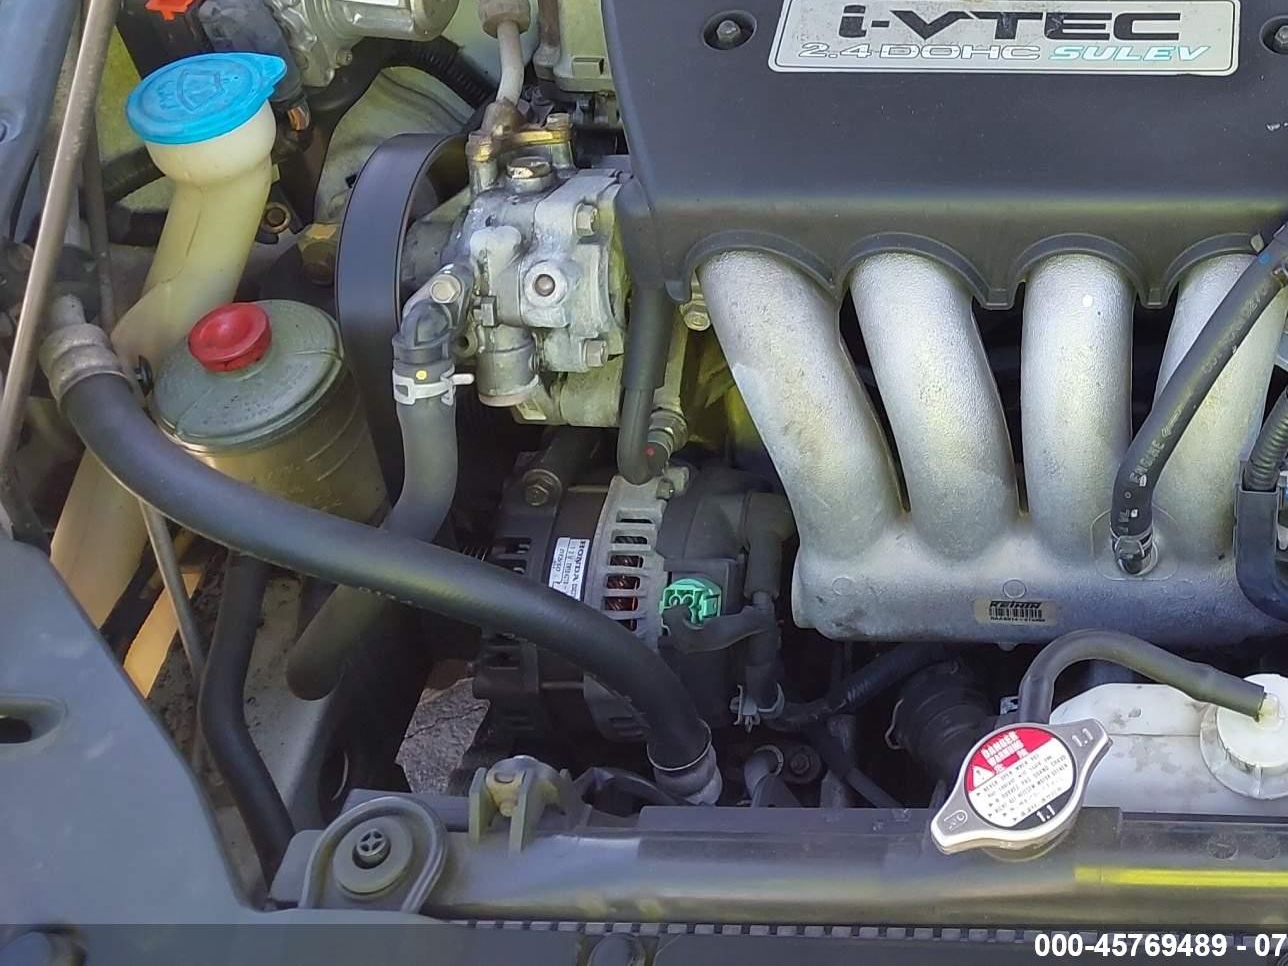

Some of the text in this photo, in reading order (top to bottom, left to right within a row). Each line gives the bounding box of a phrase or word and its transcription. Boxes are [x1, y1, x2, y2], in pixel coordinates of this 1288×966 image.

[838, 4, 1181, 41] i-VTEC
[797, 42, 1211, 62] 2.4 DOHC SULEV
[572, 540, 586, 582] HONDA
[981, 731, 1021, 758] DANGER
[1071, 727, 1095, 748] 1.1
[1036, 804, 1056, 823] 1.1
